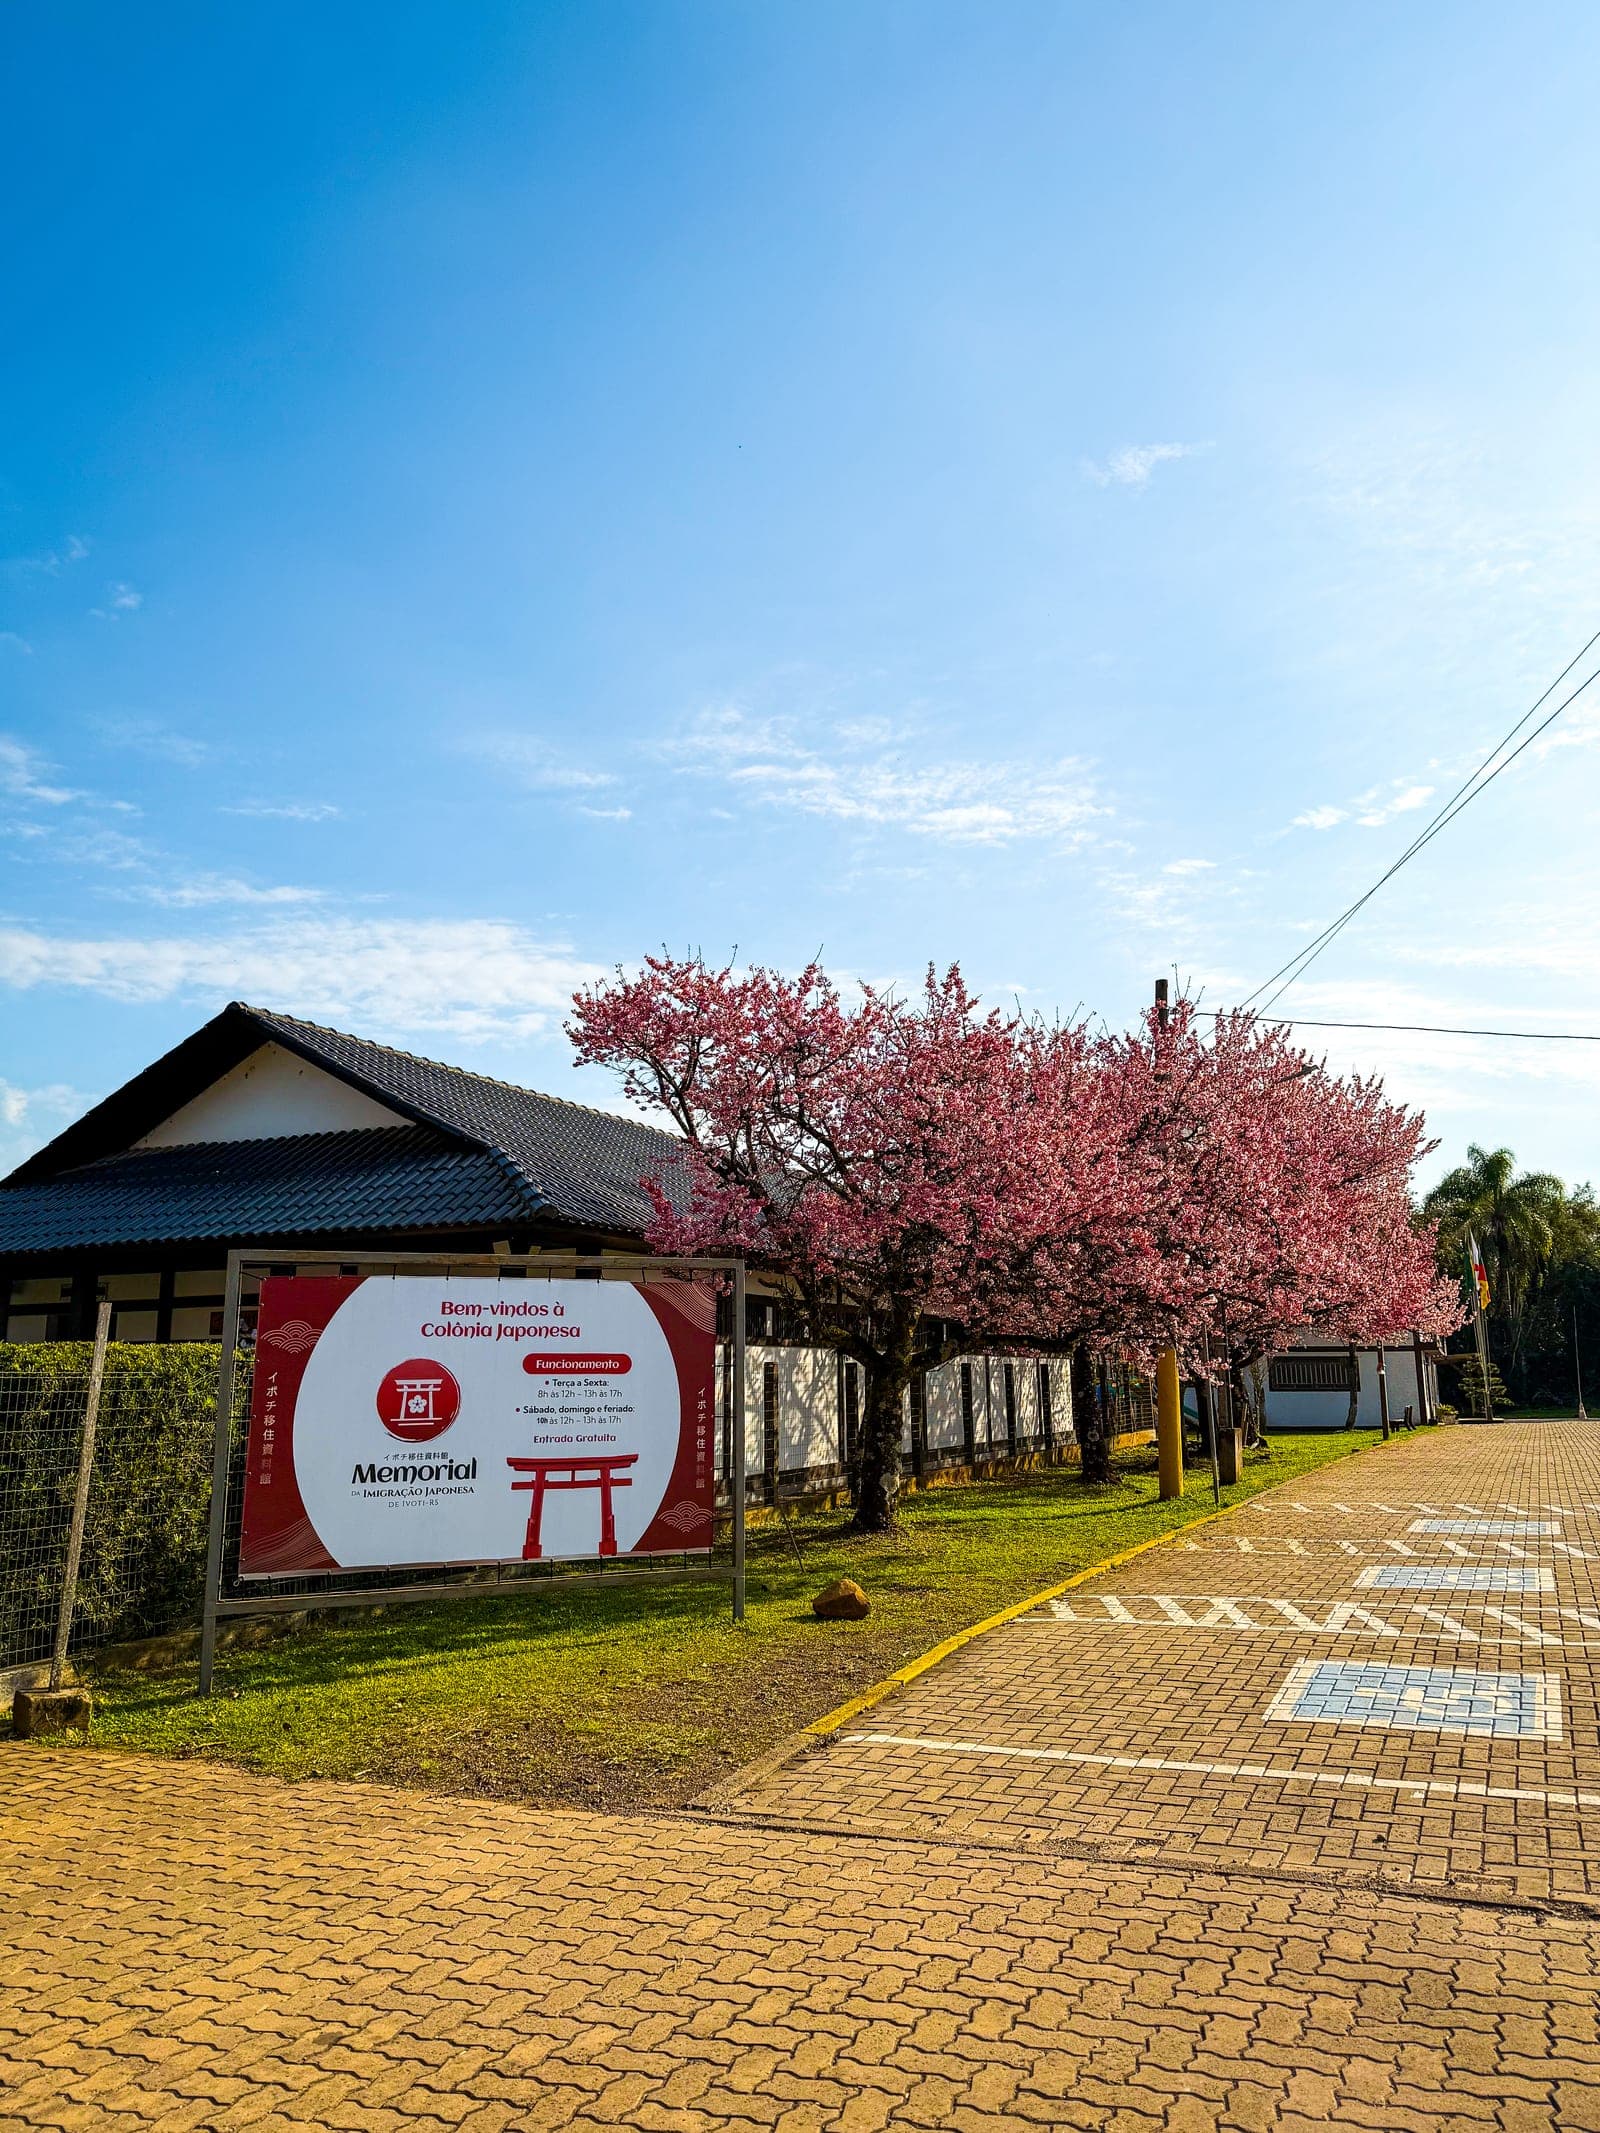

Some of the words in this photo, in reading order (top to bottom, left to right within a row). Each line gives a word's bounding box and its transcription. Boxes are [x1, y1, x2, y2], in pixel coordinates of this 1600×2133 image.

[440, 1301, 549, 1317] Bem-vindos
[553, 1301, 565, 1316] à
[421, 1321, 493, 1339] Colônia
[496, 1323, 581, 1341] Japonesa
[536, 1359, 620, 1370] Funcionamento
[552, 1379, 575, 1388] Terça
[584, 1379, 609, 1387] Sexta:
[538, 1390, 548, 1398] 8h
[562, 1390, 575, 1398] 12h
[610, 1389, 622, 1397] 17h
[523, 1405, 557, 1414] Sábado,
[559, 1405, 595, 1414] domingo
[604, 1404, 635, 1413] feriado:
[561, 1416, 574, 1424] 12h
[584, 1416, 596, 1424] 13h
[609, 1416, 621, 1424] 17h
[534, 1435, 573, 1444] Entrada
[576, 1433, 616, 1442] Gratuita
[352, 1457, 477, 1484] Memorial
[363, 1487, 423, 1498] IMIGRAÇÃO
[425, 1486, 475, 1497] JAPONESA
[402, 1499, 439, 1507] IVOTI-RS
